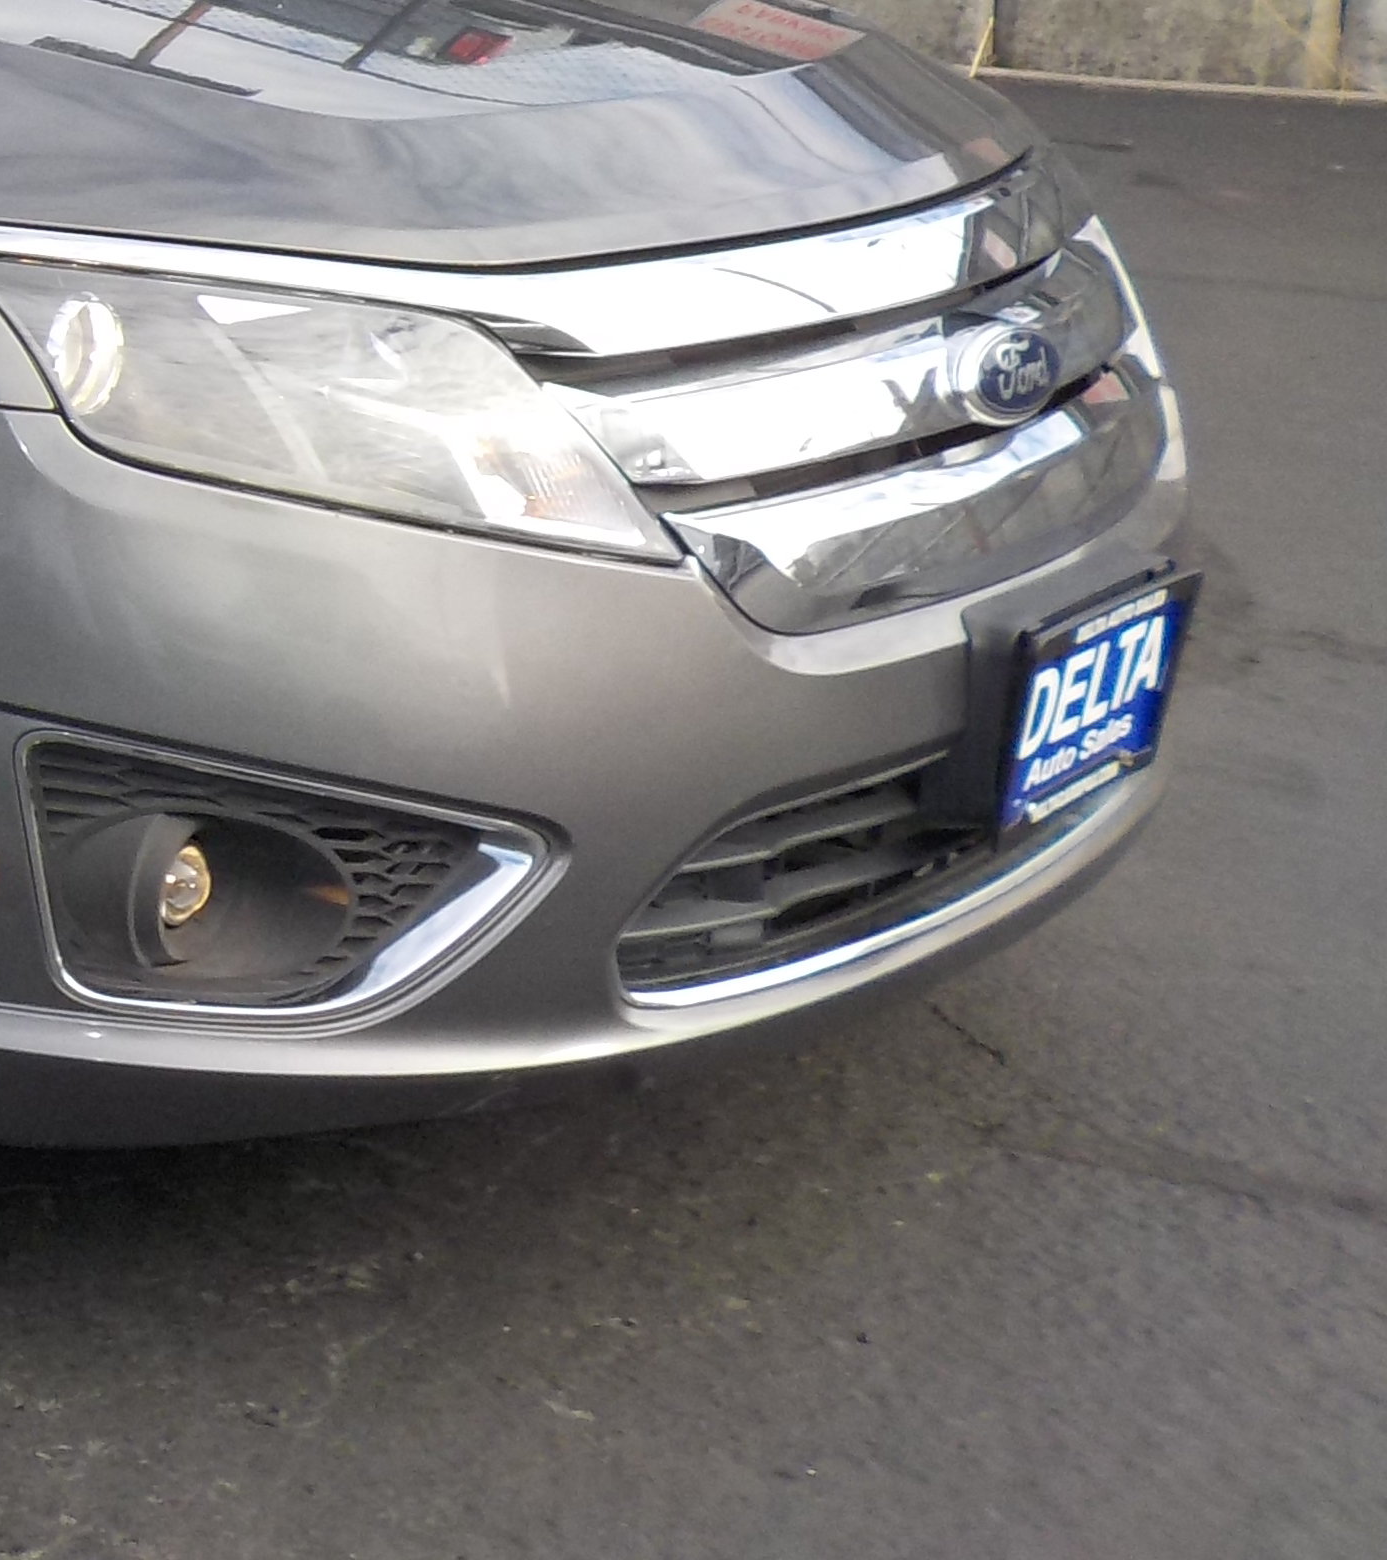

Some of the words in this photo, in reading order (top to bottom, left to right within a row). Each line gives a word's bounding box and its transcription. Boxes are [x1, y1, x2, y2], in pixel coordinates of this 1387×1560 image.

[995, 339, 1051, 401] Ford
[1017, 614, 1166, 761] DELTA
[1023, 746, 1077, 792] Auto
[1079, 713, 1134, 761] Sales
